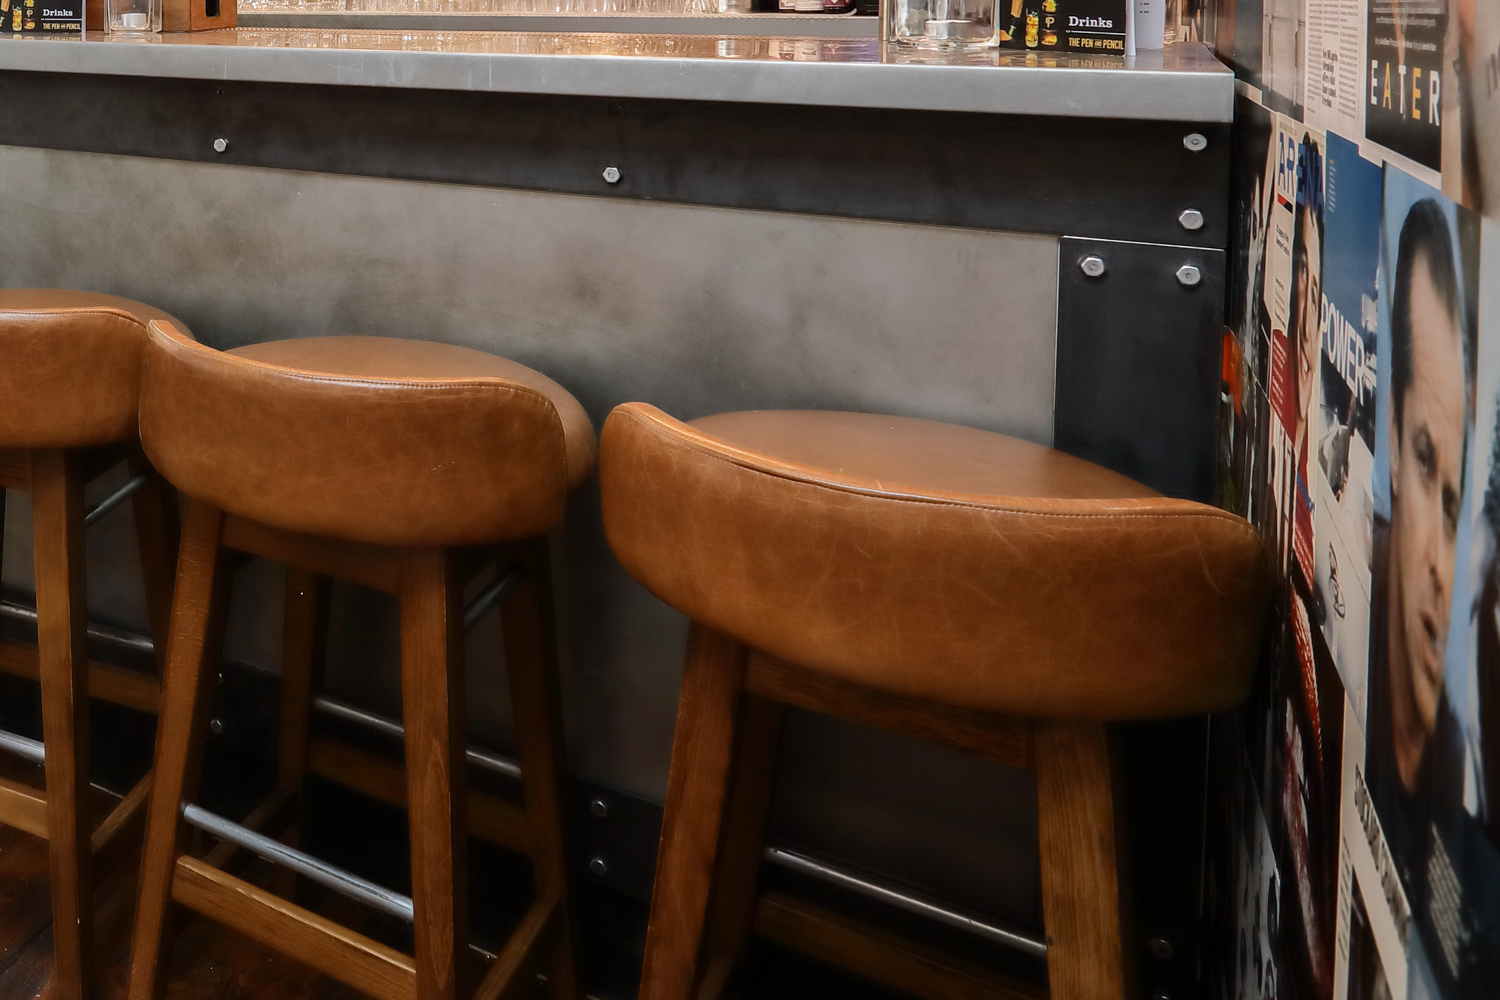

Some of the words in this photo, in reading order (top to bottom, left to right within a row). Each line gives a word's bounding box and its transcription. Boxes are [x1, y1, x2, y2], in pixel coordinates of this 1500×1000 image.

[42, 9, 73, 17] Drinks
[1068, 15, 1113, 28] Drinks
[1069, 37, 1080, 48] THE
[1081, 38, 1093, 48] PEN
[1103, 39, 1125, 50] PENCIL
[1370, 60, 1441, 127] EATER
[1277, 131, 1325, 222] ARENA
[1320, 292, 1364, 407] POWER
